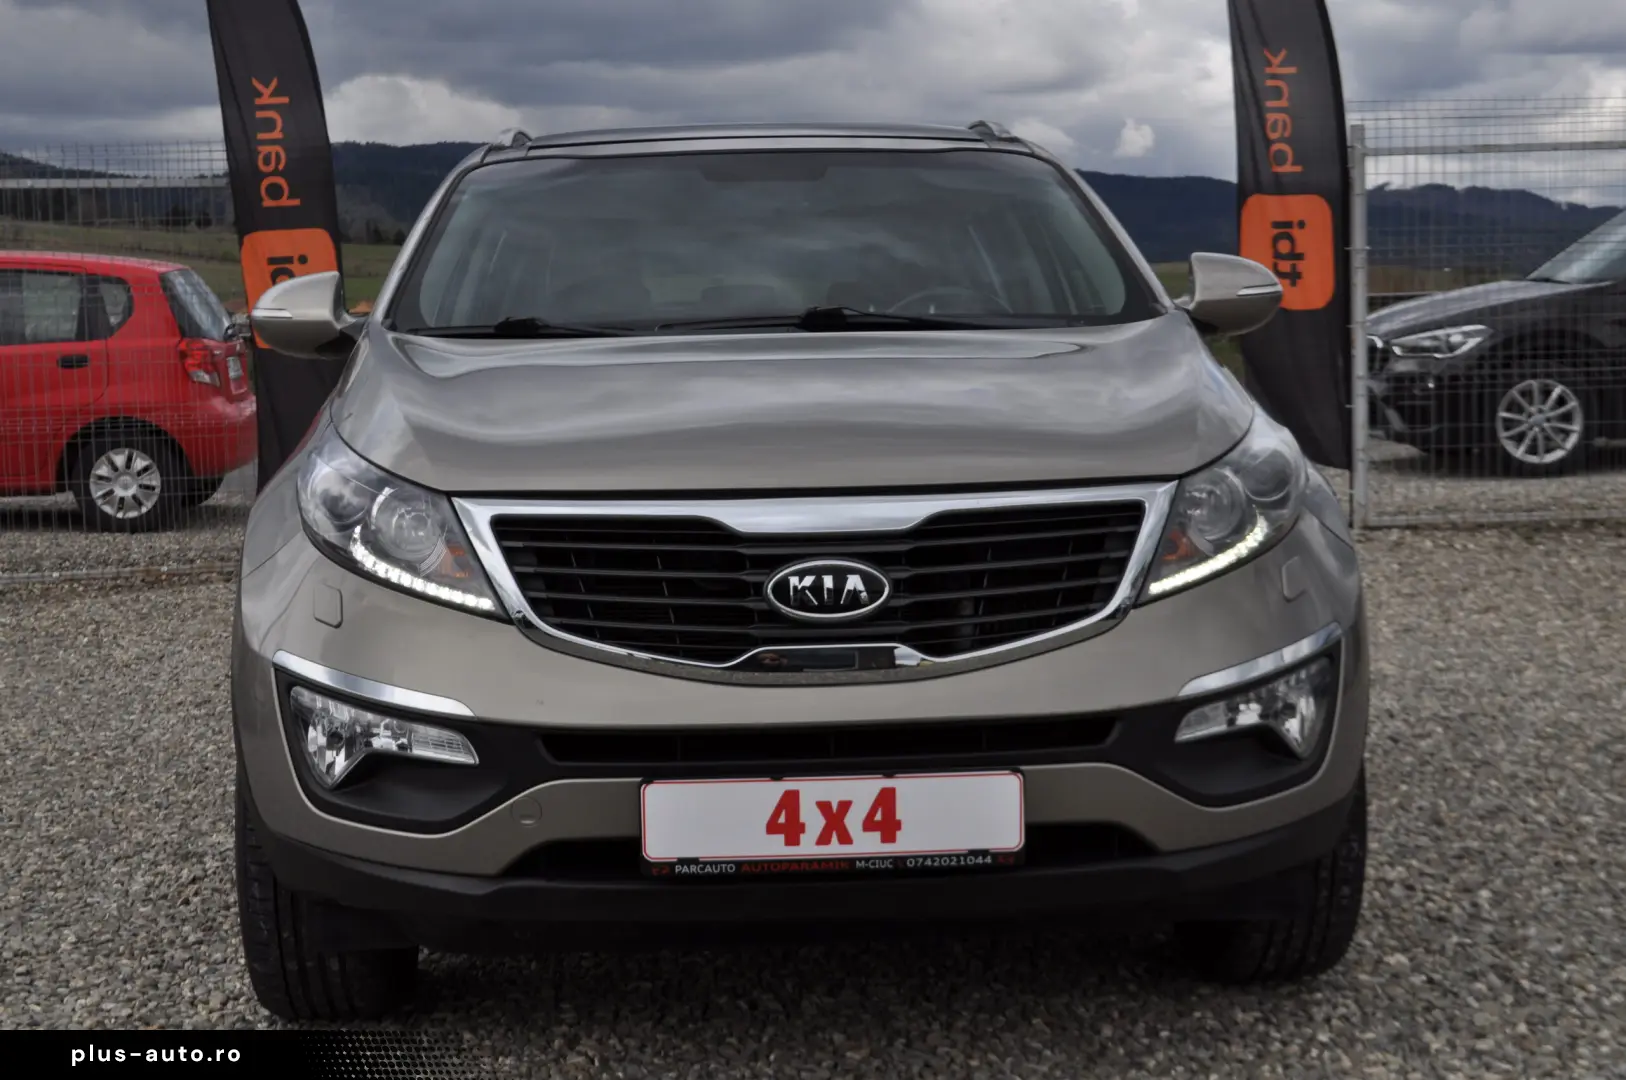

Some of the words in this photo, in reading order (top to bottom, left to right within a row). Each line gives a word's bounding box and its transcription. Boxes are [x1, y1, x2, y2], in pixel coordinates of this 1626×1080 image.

[788, 574, 869, 605] KIA
[765, 786, 902, 847] 4x4
[675, 863, 736, 874] PARCAUTO
[855, 858, 893, 869] M-CIUC
[906, 855, 992, 867] 0742021044
